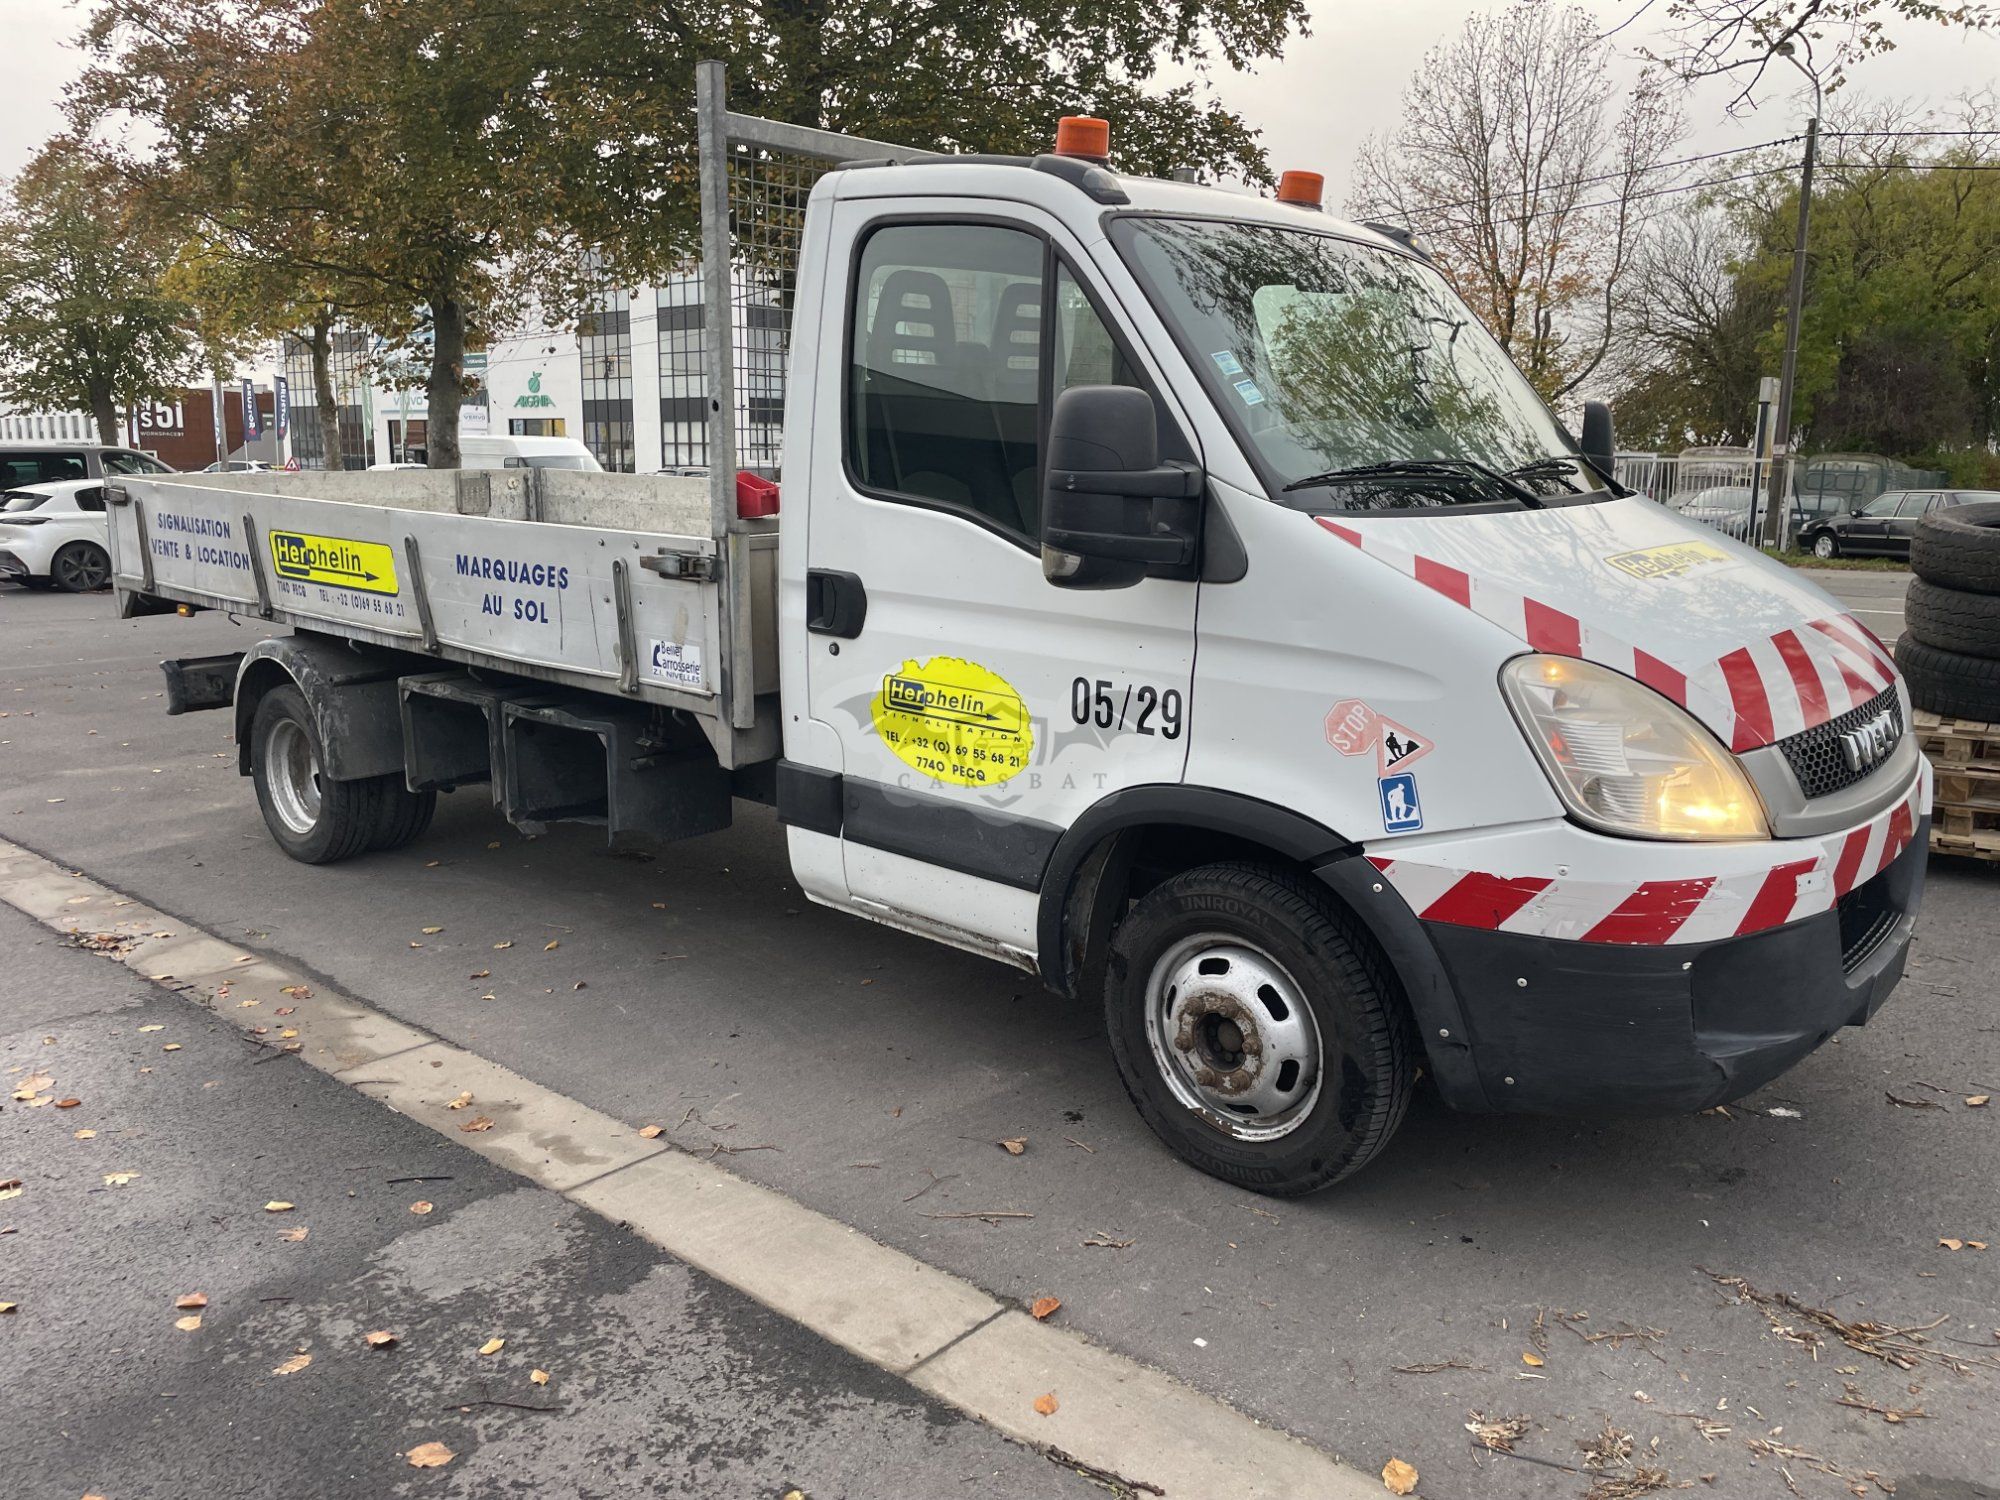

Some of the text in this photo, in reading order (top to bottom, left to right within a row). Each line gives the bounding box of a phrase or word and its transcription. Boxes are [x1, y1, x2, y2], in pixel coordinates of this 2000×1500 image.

[157, 512, 231, 540] SIGNALISATION
[151, 538, 250, 571] VENTE & LOCATION
[277, 537, 361, 572] Herphelin
[456, 553, 569, 590] MARQUAGES
[319, 588, 330, 603] TEL
[373, 598, 382, 613] 55
[384, 601, 393, 616] 68
[396, 602, 405, 617] 21
[482, 593, 548, 624] AU SOL
[666, 670, 700, 684] NIVELLES
[890, 680, 984, 713] Herphelin
[1071, 676, 1183, 740] 05/29
[882, 710, 1022, 743] SIGNALISATION
[1332, 704, 1369, 750] STOP
[885, 730, 900, 743] TEL
[911, 736, 929, 749] +32
[955, 745, 968, 756] 69
[973, 748, 986, 761] 55
[991, 752, 1004, 765] 68
[1009, 755, 1020, 768] 21
[916, 756, 986, 782] 7740 PECQ
